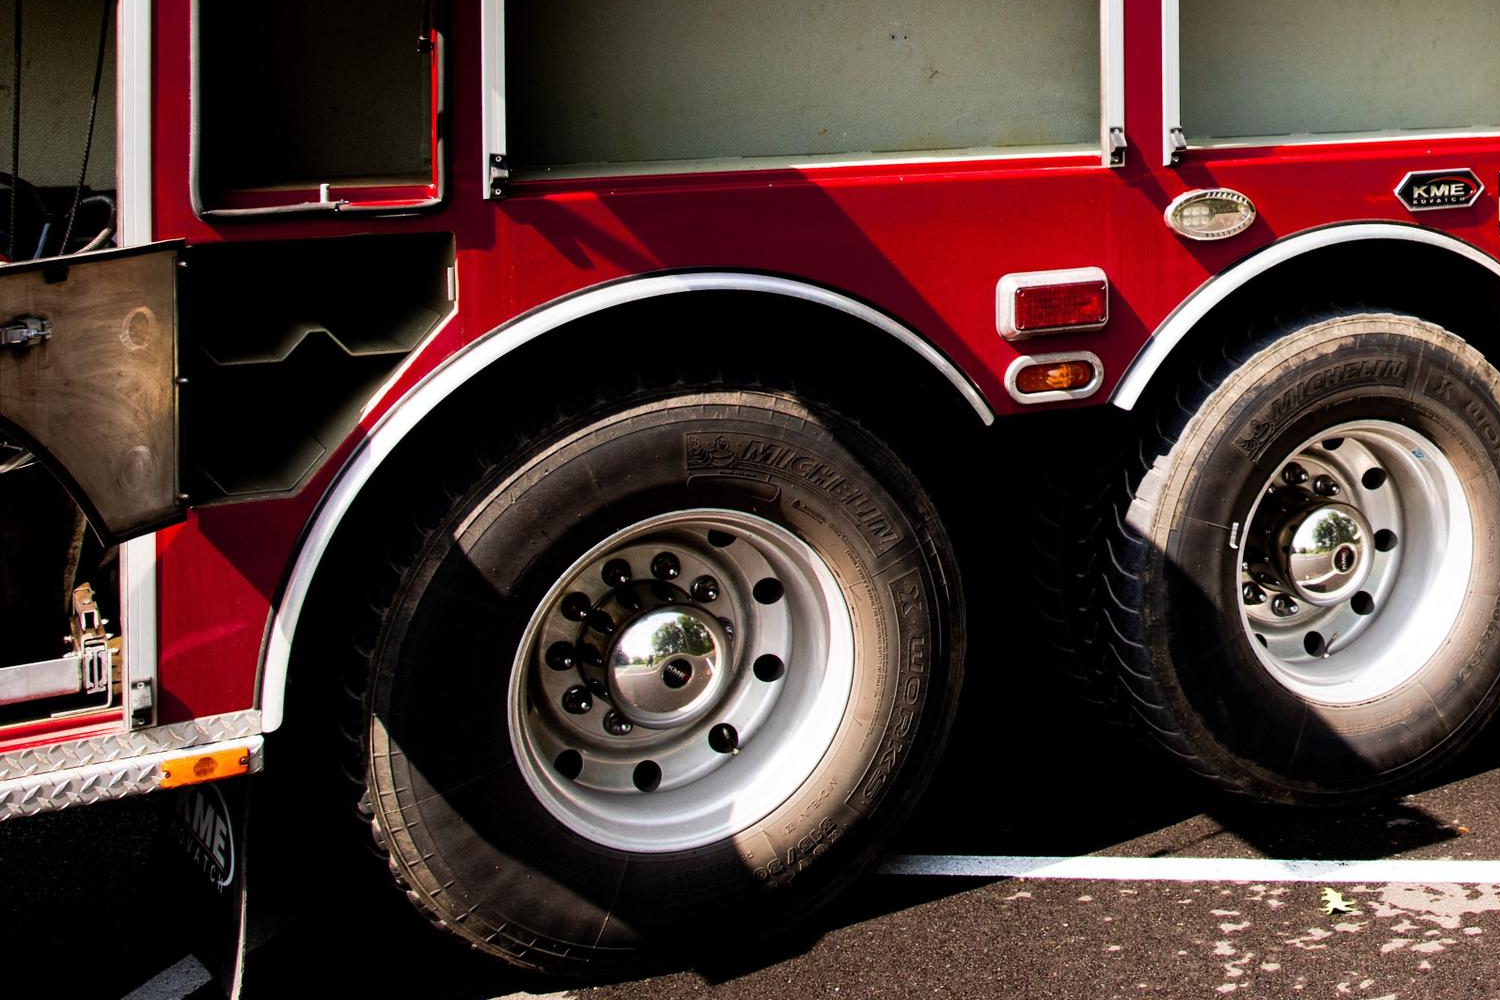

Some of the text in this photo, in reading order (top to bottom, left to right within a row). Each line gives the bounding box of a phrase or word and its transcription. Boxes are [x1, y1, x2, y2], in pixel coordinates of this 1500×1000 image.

[1412, 183, 1465, 198] KME
[1412, 197, 1466, 205] KOVATCH
[1270, 358, 1404, 420] MICHELIN
[1433, 377, 1456, 402] X
[742, 440, 926, 804] MICHELIN X WORKS
[666, 664, 687, 679] KME
[172, 824, 225, 894] OVATCH
[177, 788, 228, 869] KME
